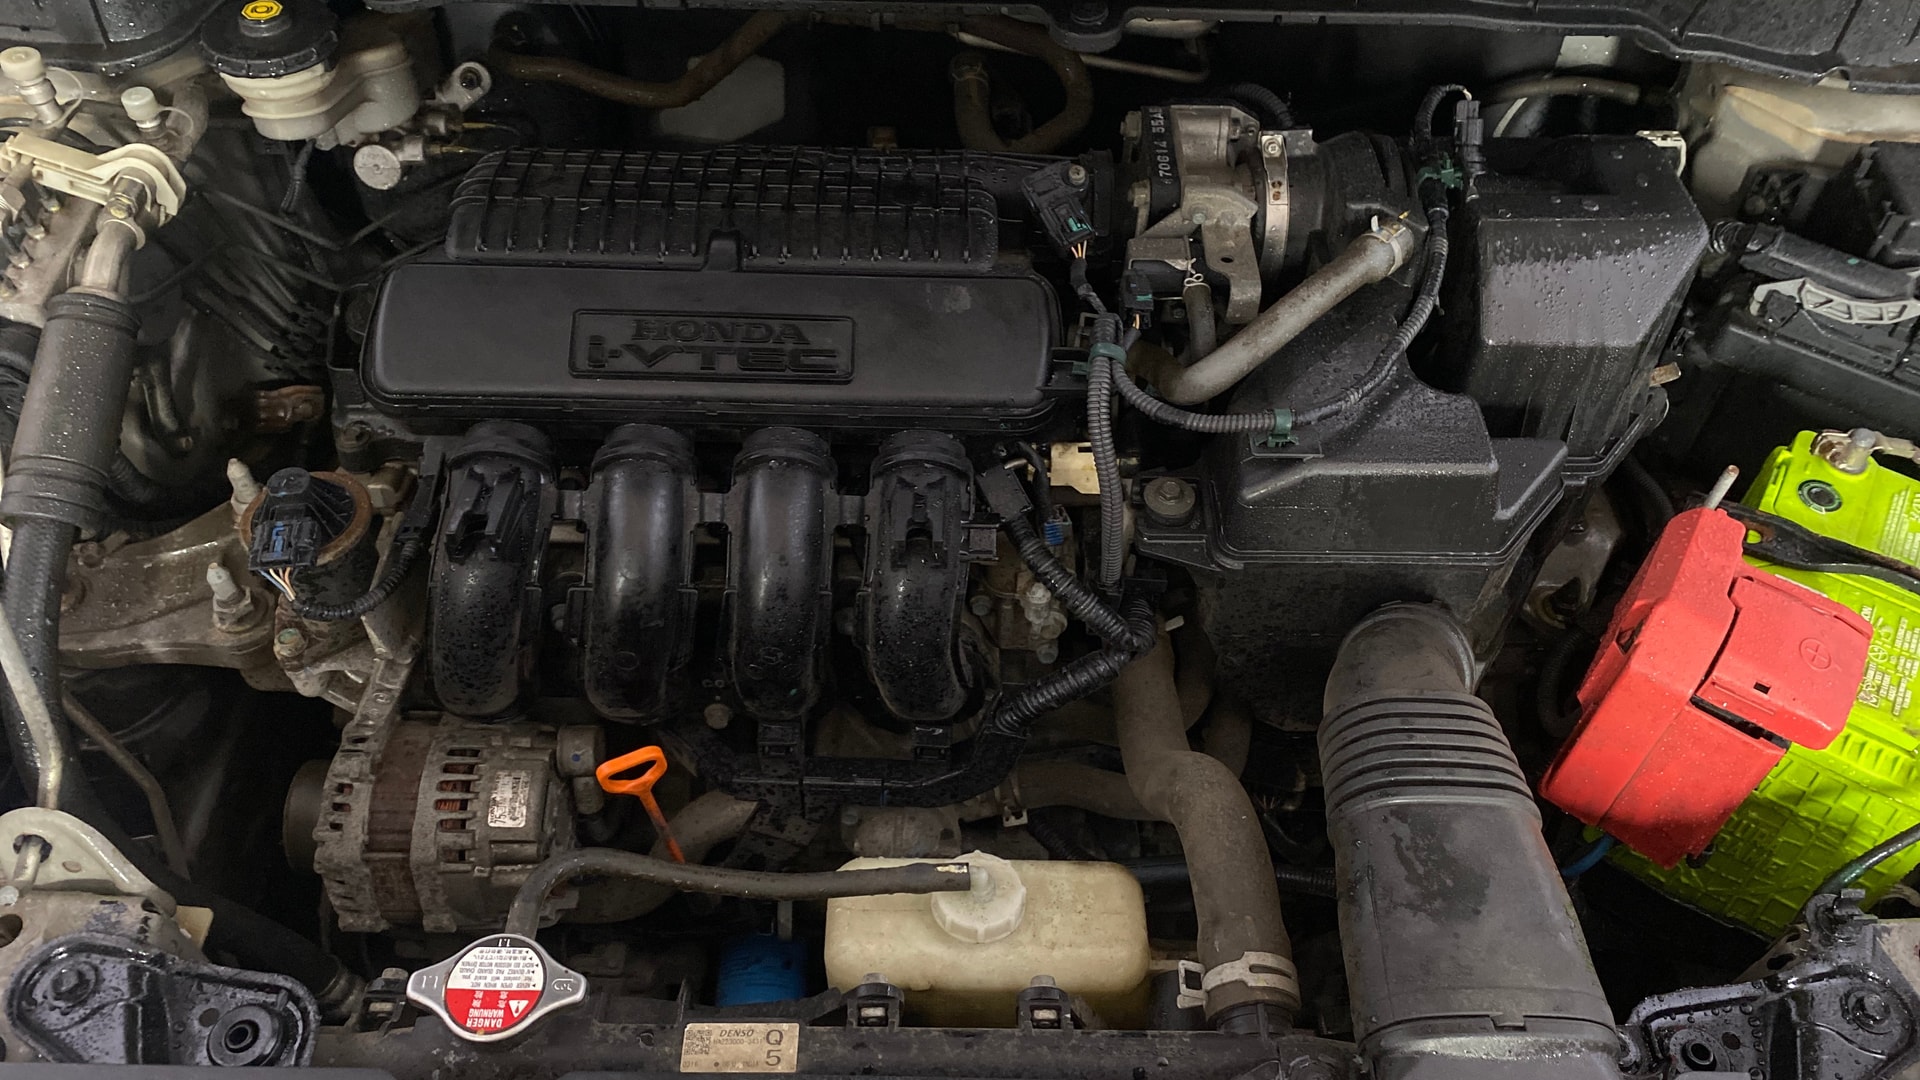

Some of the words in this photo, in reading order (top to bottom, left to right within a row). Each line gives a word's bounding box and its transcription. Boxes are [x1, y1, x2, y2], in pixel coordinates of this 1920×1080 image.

[631, 319, 811, 345] HONDA
[587, 334, 839, 374] i-VTEC
[497, 938, 511, 947] 1.1
[468, 1008, 505, 1018] WARNUNG
[465, 1017, 503, 1028] DANGER
[719, 1029, 755, 1037] DENSO
[765, 1029, 784, 1046] Q
[765, 1049, 783, 1066] 5
